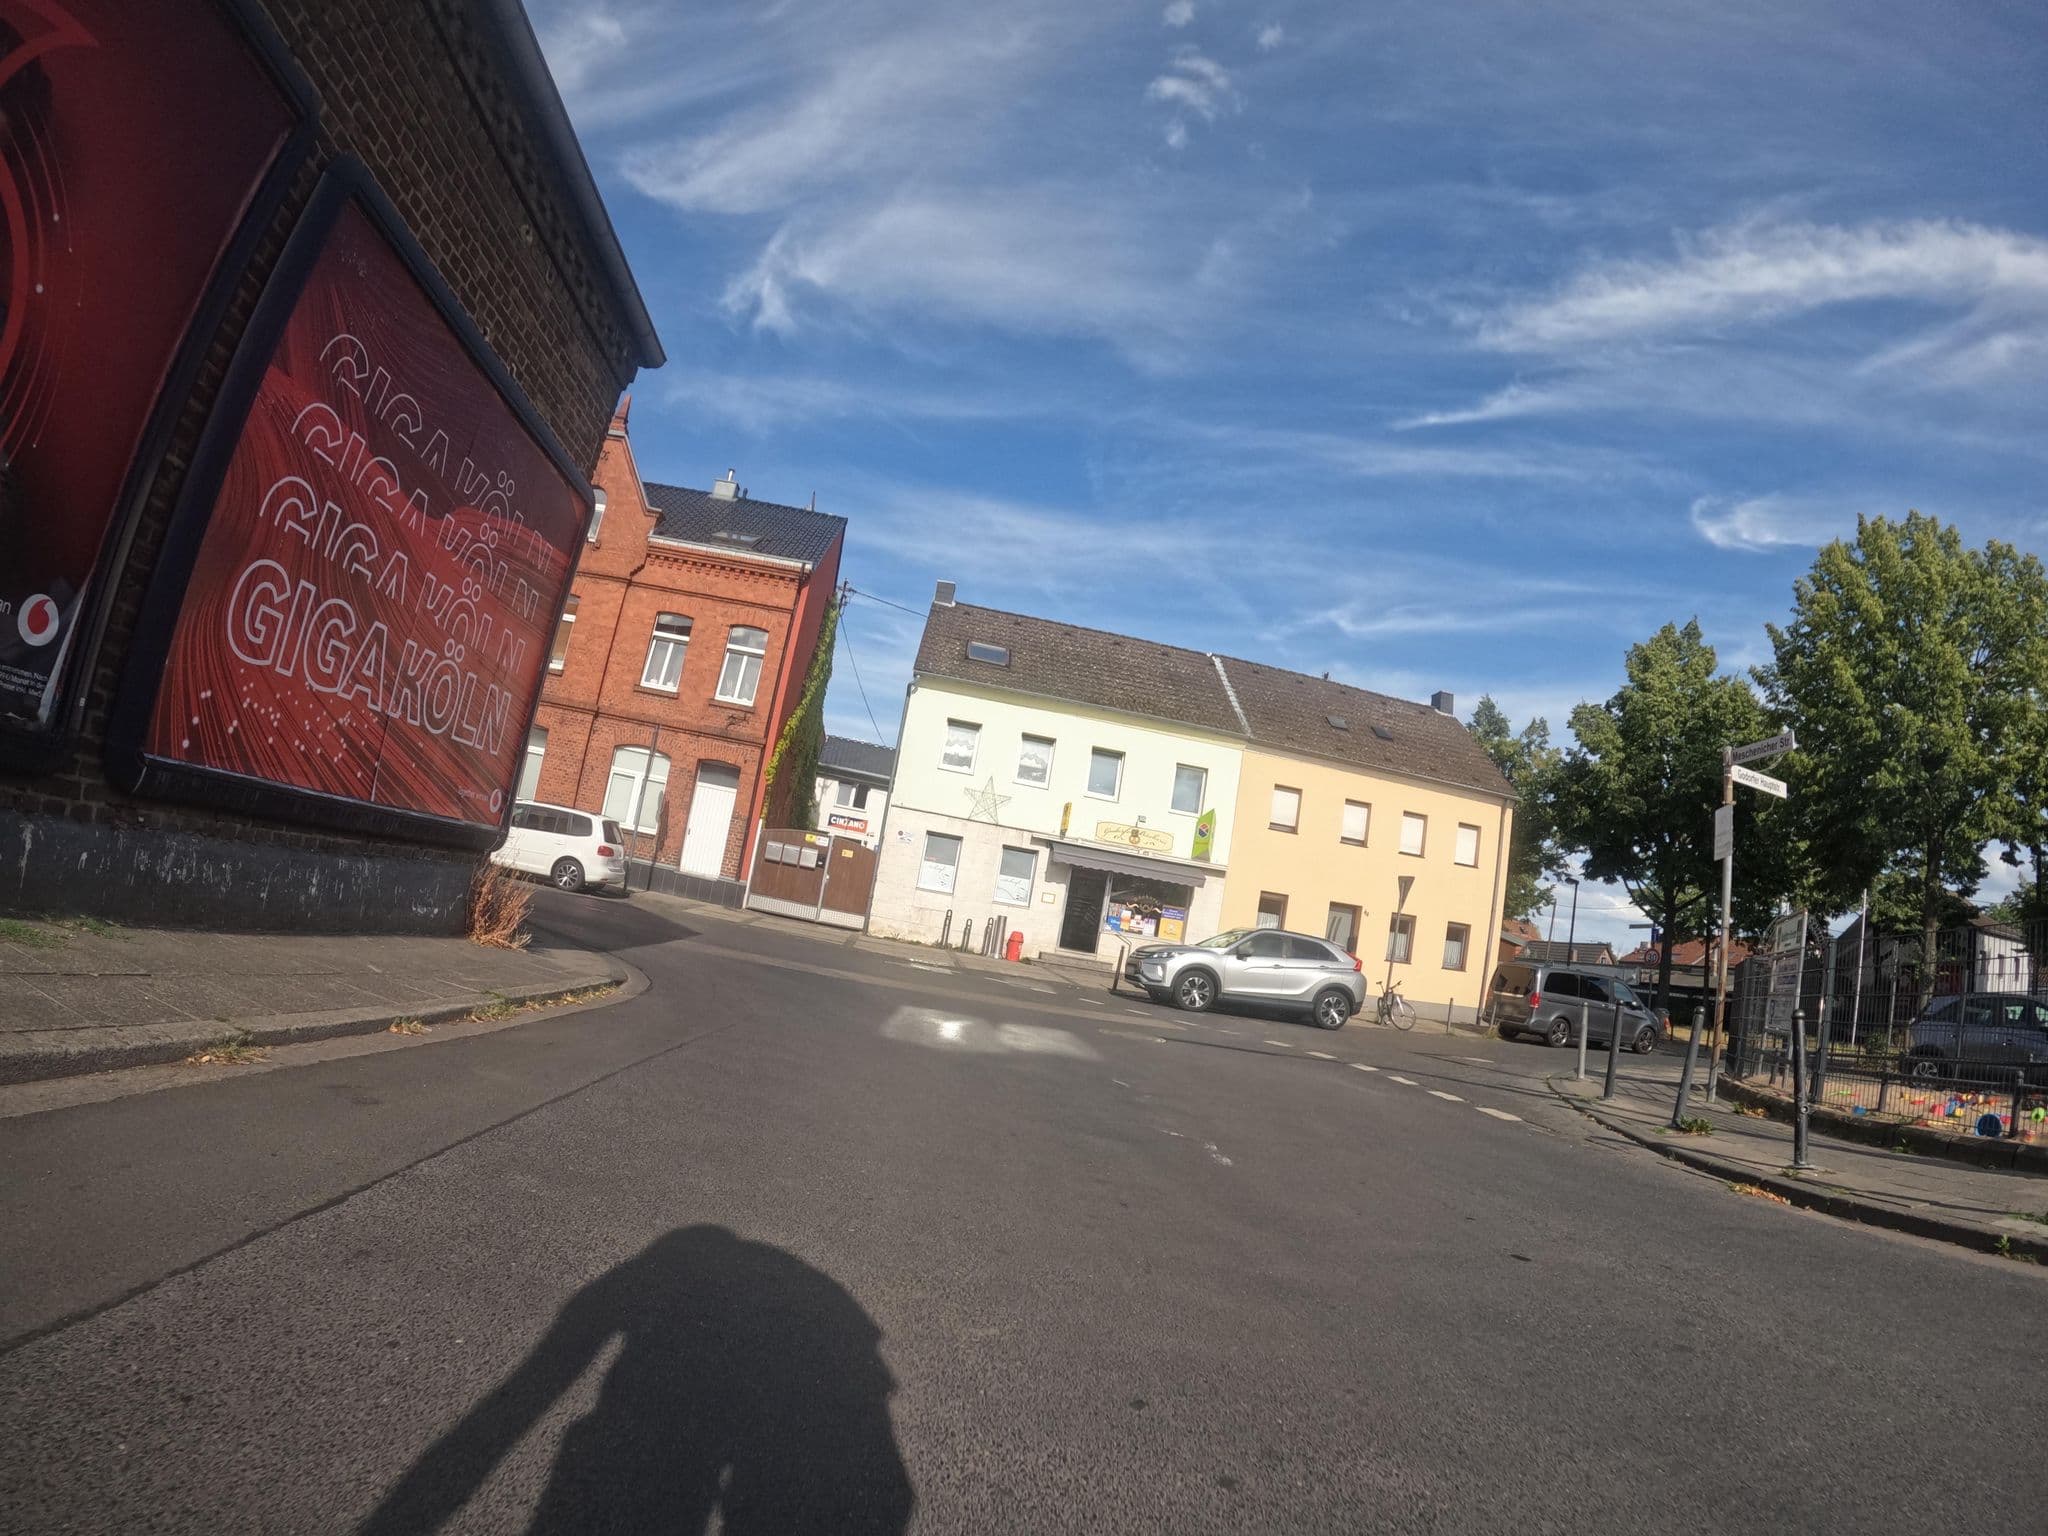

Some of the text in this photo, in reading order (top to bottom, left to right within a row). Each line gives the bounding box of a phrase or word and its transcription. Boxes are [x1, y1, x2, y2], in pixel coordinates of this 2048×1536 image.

[227, 558, 388, 712] GIGA
[1732, 742, 1778, 761] Meschenicher
[830, 816, 866, 830] CINZANO
